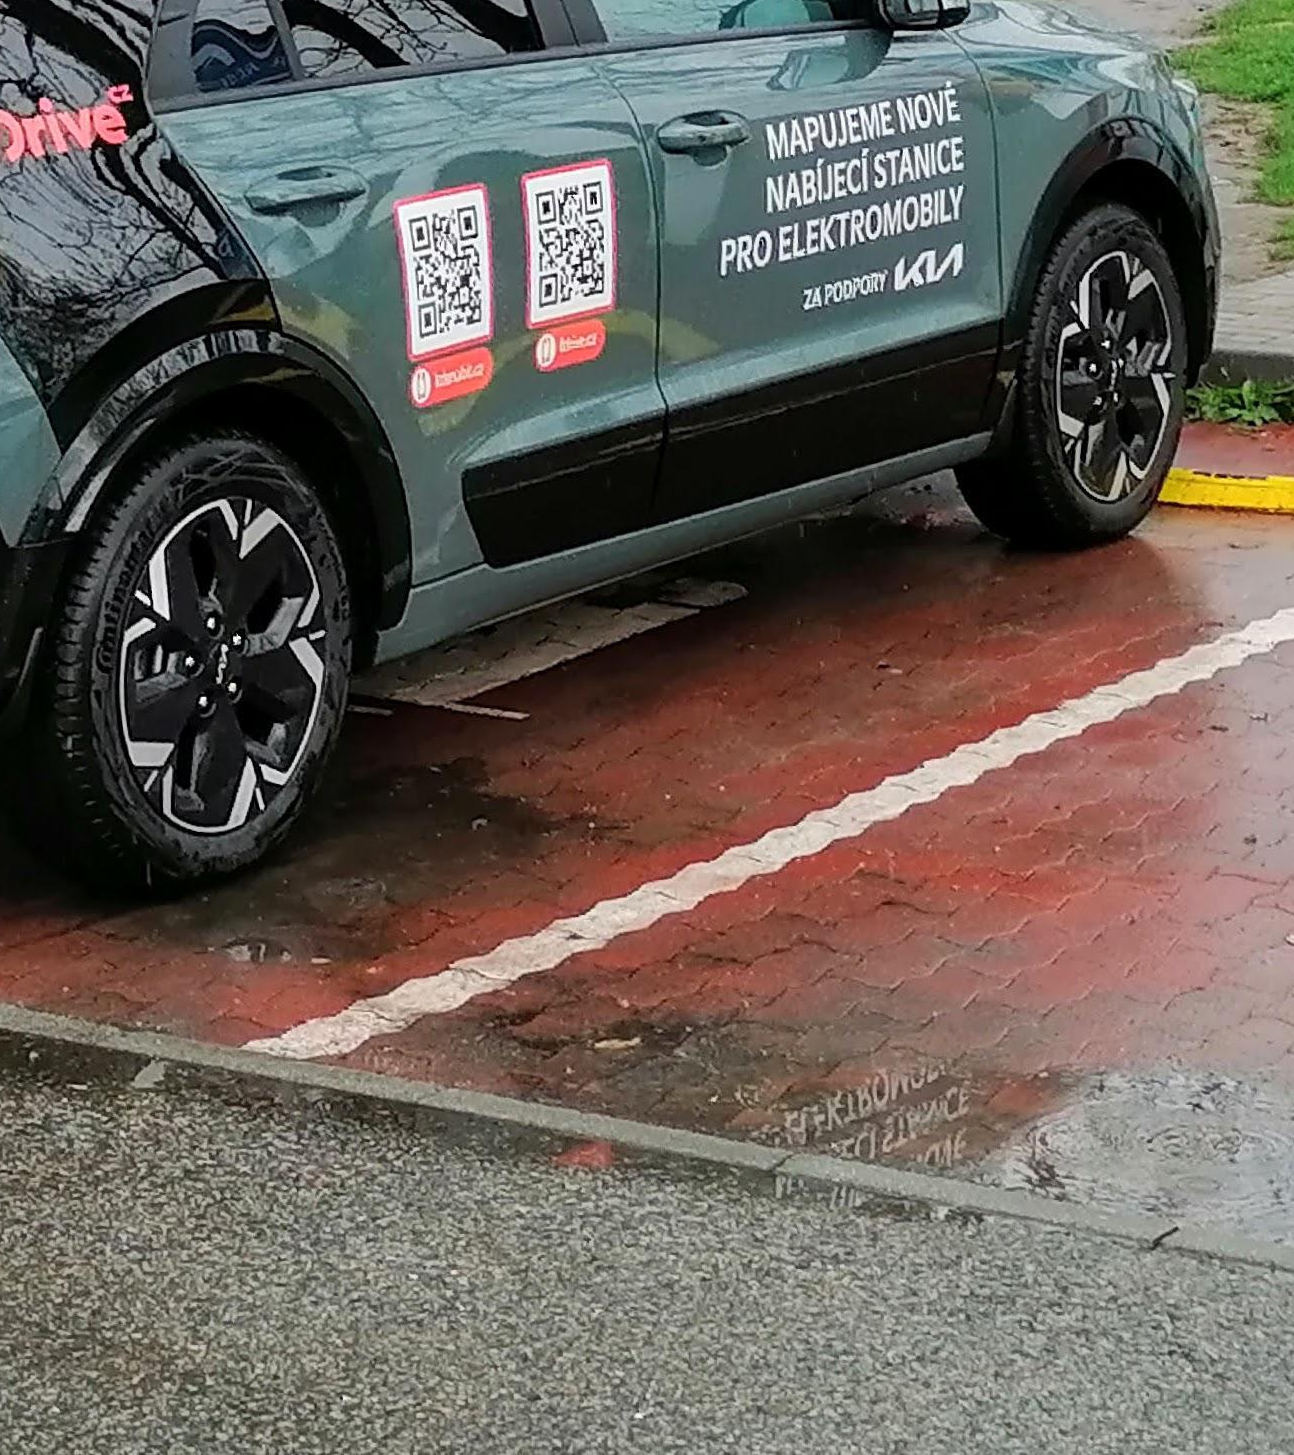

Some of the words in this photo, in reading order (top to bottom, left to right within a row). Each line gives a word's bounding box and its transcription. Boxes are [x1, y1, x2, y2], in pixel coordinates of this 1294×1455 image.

[765, 99, 895, 162] MAPUJEME
[896, 81, 961, 134] NOVÉ
[764, 147, 869, 214] NABÍJECÍ
[873, 136, 965, 190] STANICE
[718, 229, 773, 277] PRO
[778, 184, 965, 263] ELEKTROMOBILY
[802, 288, 822, 311] ZA
[823, 269, 889, 306] PODPORY
